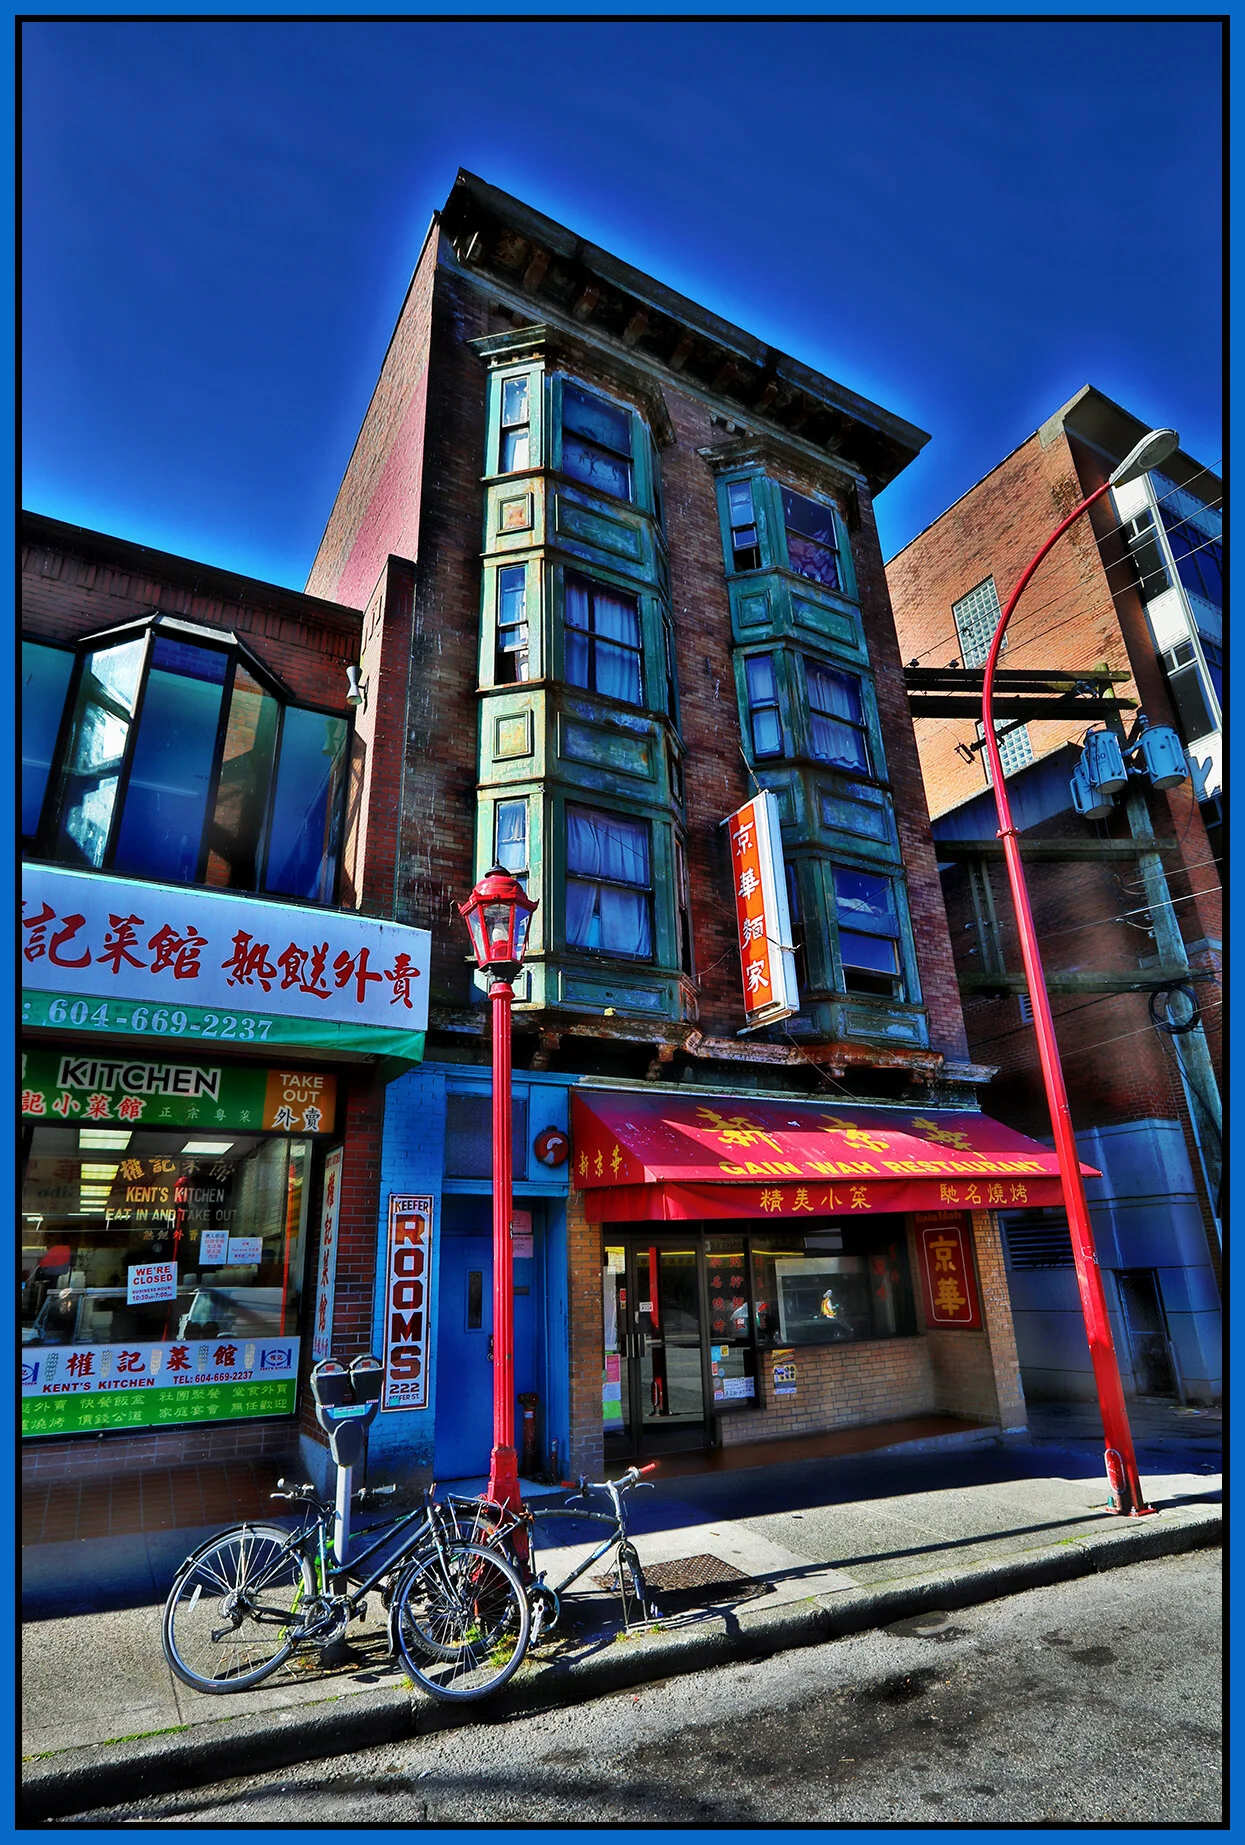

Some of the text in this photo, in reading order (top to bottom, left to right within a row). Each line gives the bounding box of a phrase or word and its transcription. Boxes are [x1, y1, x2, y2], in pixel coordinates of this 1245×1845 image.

[49, 998, 273, 1041] 604-669-2237
[57, 1057, 221, 1101] KITCHEN
[280, 1074, 324, 1089] TAKE
[283, 1089, 320, 1103] OUT
[272, 1105, 322, 1132] 外賣
[718, 1160, 1047, 1175] GAIN WAH RESTAURANT
[125, 1186, 225, 1204] KENT'S KITCHEN
[760, 1183, 1028, 1212] 精美小菜 馳名燒烤
[105, 1208, 133, 1221] EAT
[136, 1208, 149, 1221] IN
[151, 1208, 176, 1221] AND
[180, 1208, 211, 1221] TAKE
[394, 1200, 429, 1213] KEEFER
[133, 1274, 173, 1285] CLOSED
[136, 1266, 171, 1276] WE'RE
[928, 1235, 967, 1316] 京華
[389, 1214, 425, 1381] ROOMS
[65, 1344, 238, 1378] 權記菜館
[42, 1371, 254, 1393] KENT'S KITCHEN TEL: 604-669-2237
[389, 1383, 419, 1395] 222
